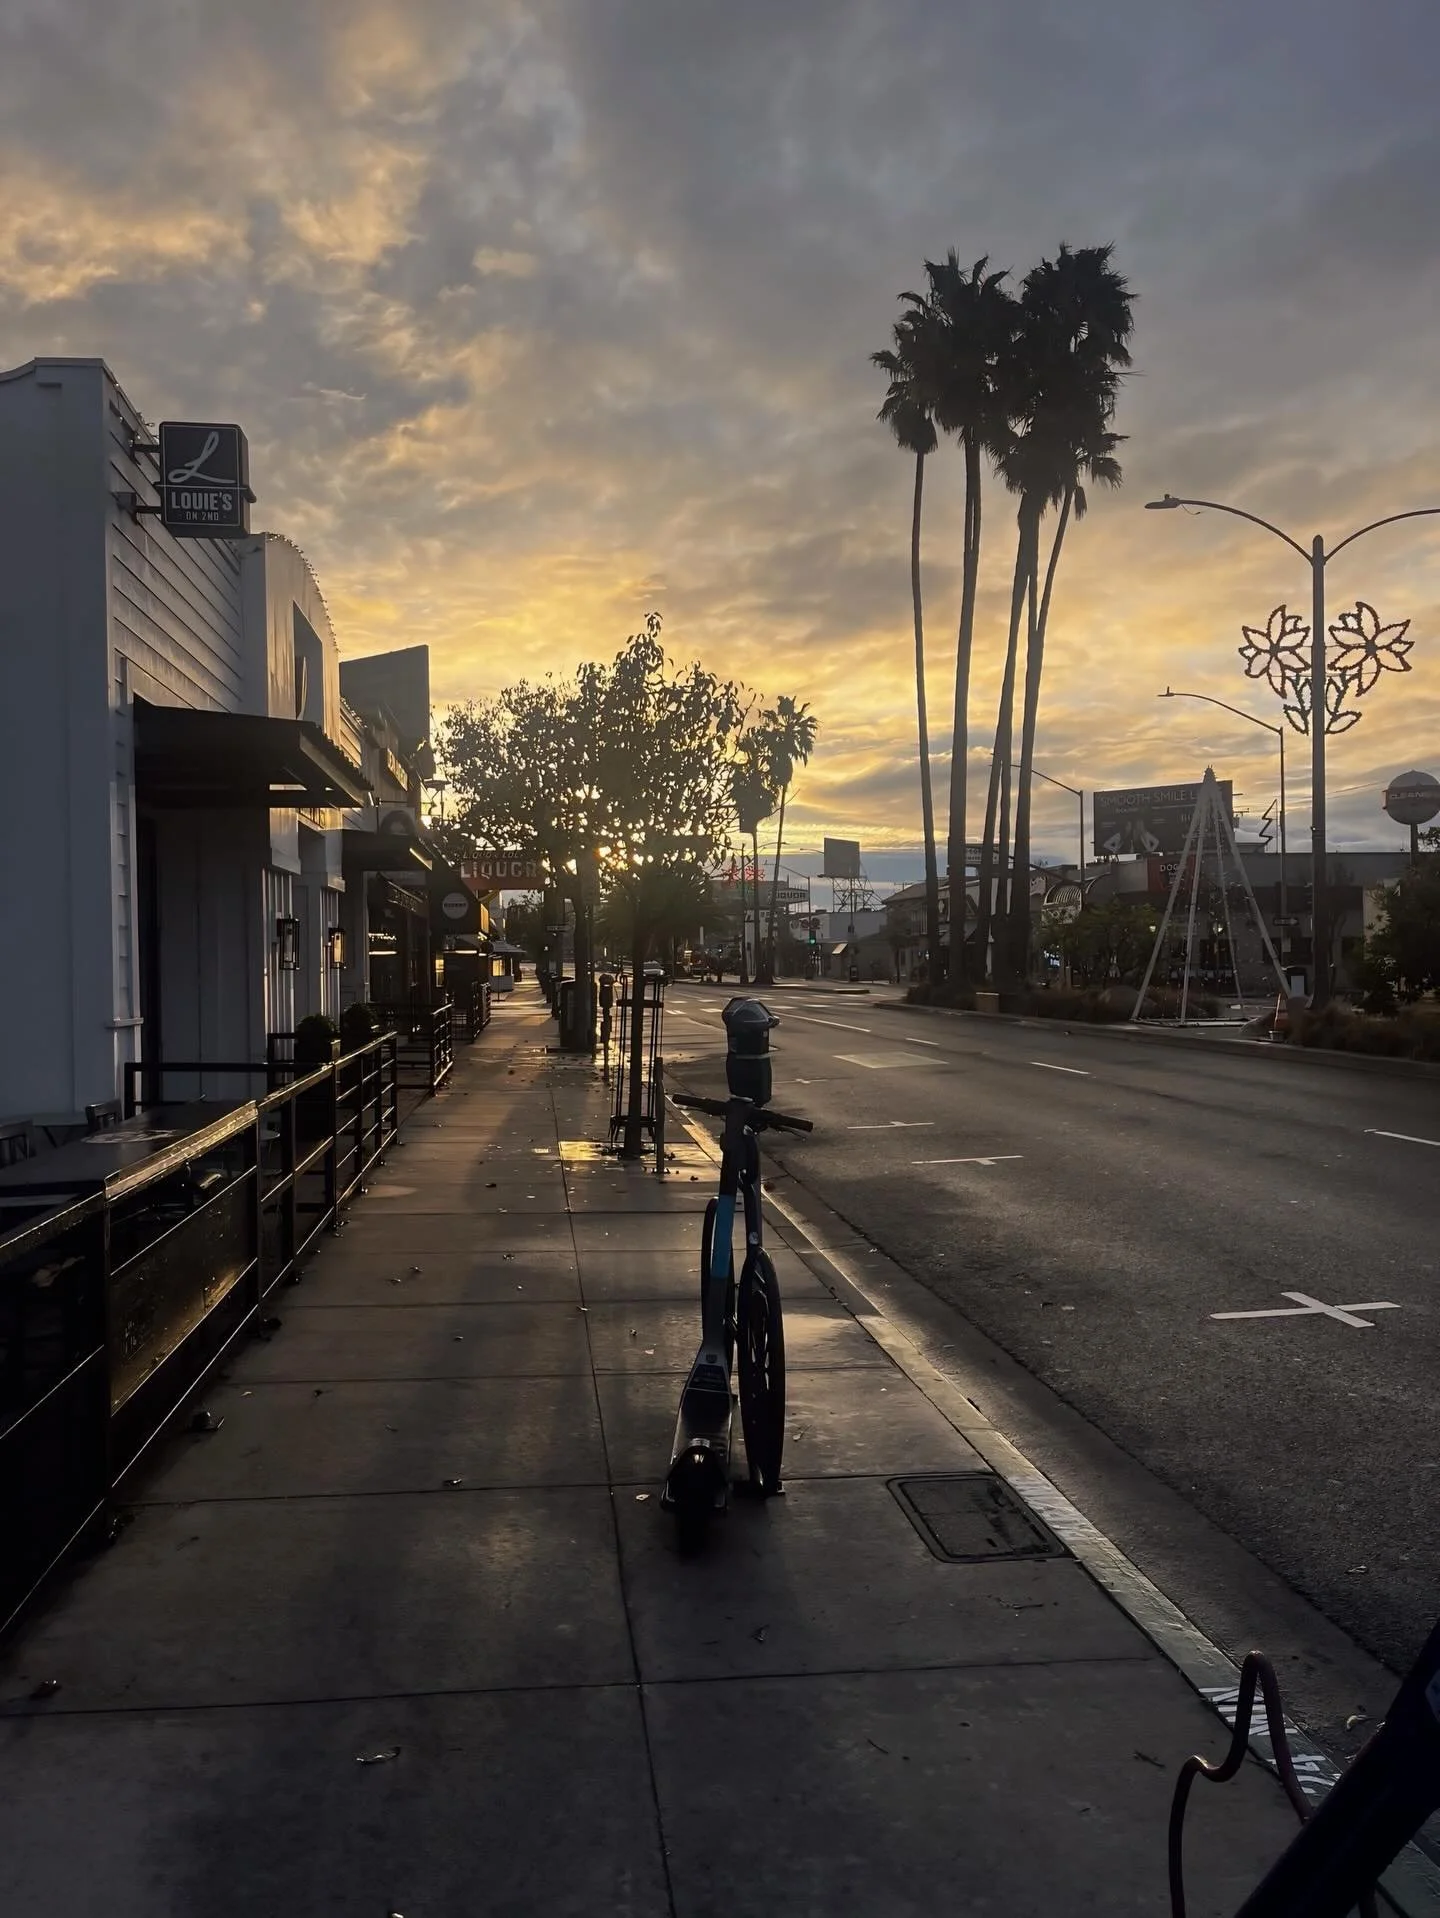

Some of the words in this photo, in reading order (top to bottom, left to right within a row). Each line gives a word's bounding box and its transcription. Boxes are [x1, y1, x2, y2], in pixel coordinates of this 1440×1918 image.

[168, 431, 236, 483] L
[171, 491, 233, 511] LOUIE'S
[186, 511, 198, 520] ON
[202, 511, 219, 521] 2ND
[1153, 789, 1186, 802] SMILE
[776, 891, 806, 899] IQUOR
